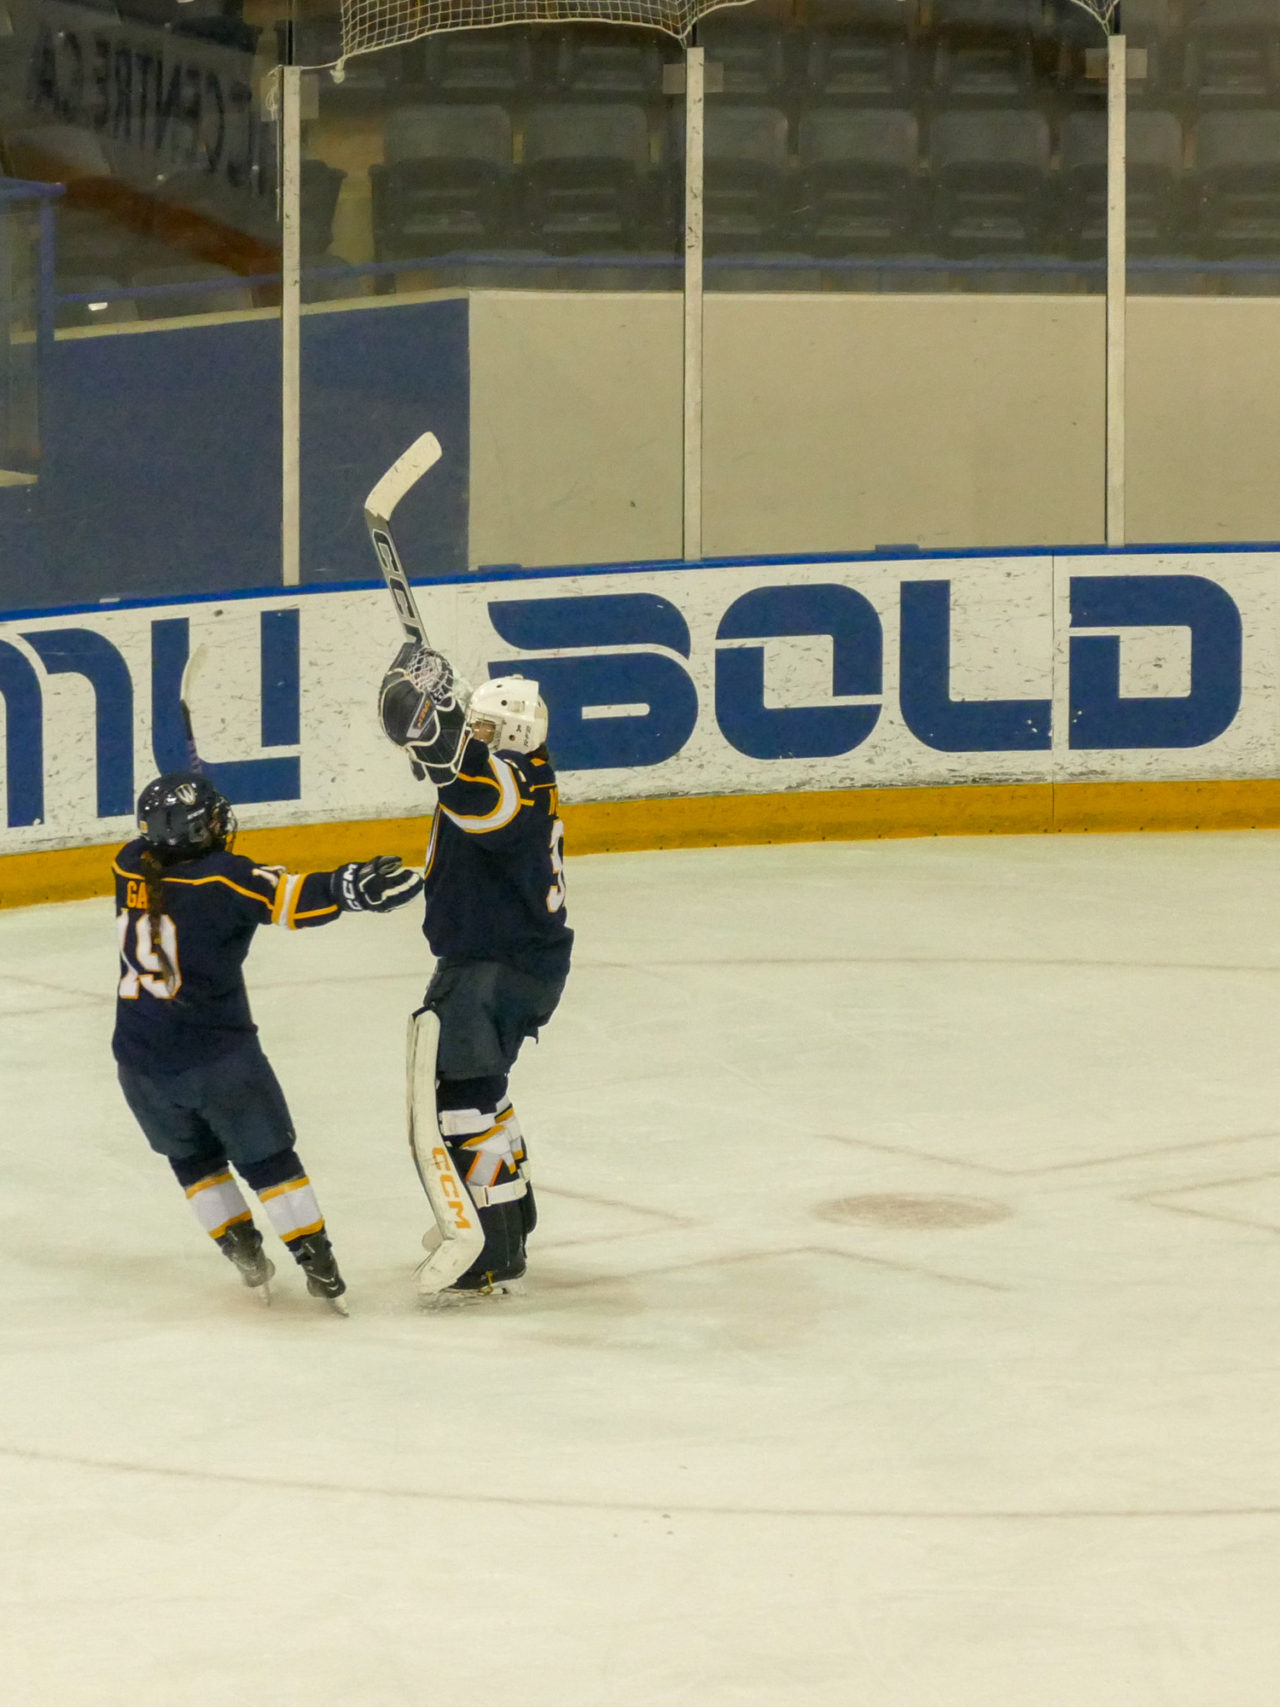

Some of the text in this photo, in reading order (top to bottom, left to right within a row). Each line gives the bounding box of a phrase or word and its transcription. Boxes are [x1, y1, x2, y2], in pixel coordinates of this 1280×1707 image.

[487, 574, 1243, 771] BOLD
[116, 906, 182, 1000] 19
[431, 1147, 472, 1229] CCM
